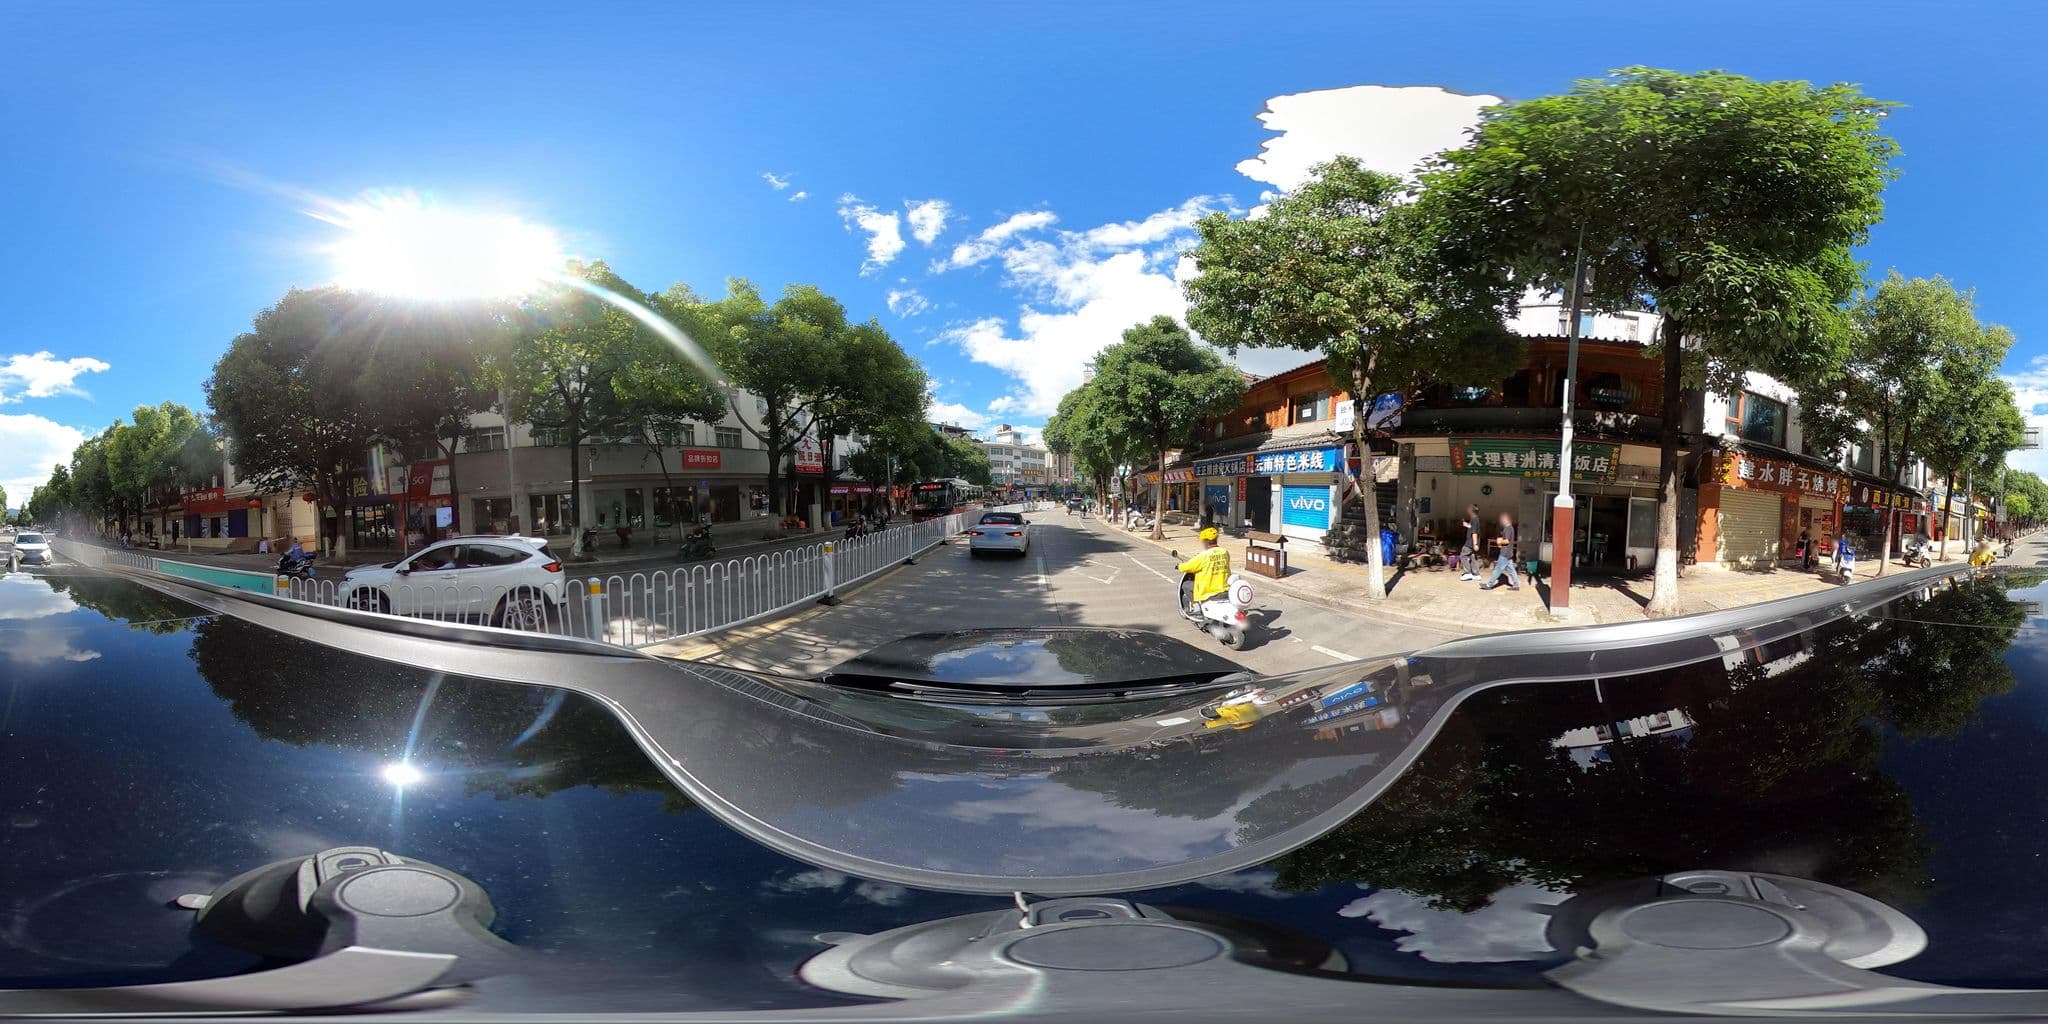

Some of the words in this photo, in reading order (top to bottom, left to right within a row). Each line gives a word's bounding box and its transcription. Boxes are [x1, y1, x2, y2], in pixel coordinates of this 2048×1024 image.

[1255, 452, 1325, 474] 云南特色米线
[1738, 459, 1839, 495] 建水胖子烧烤
[1291, 495, 1325, 511] vivo
